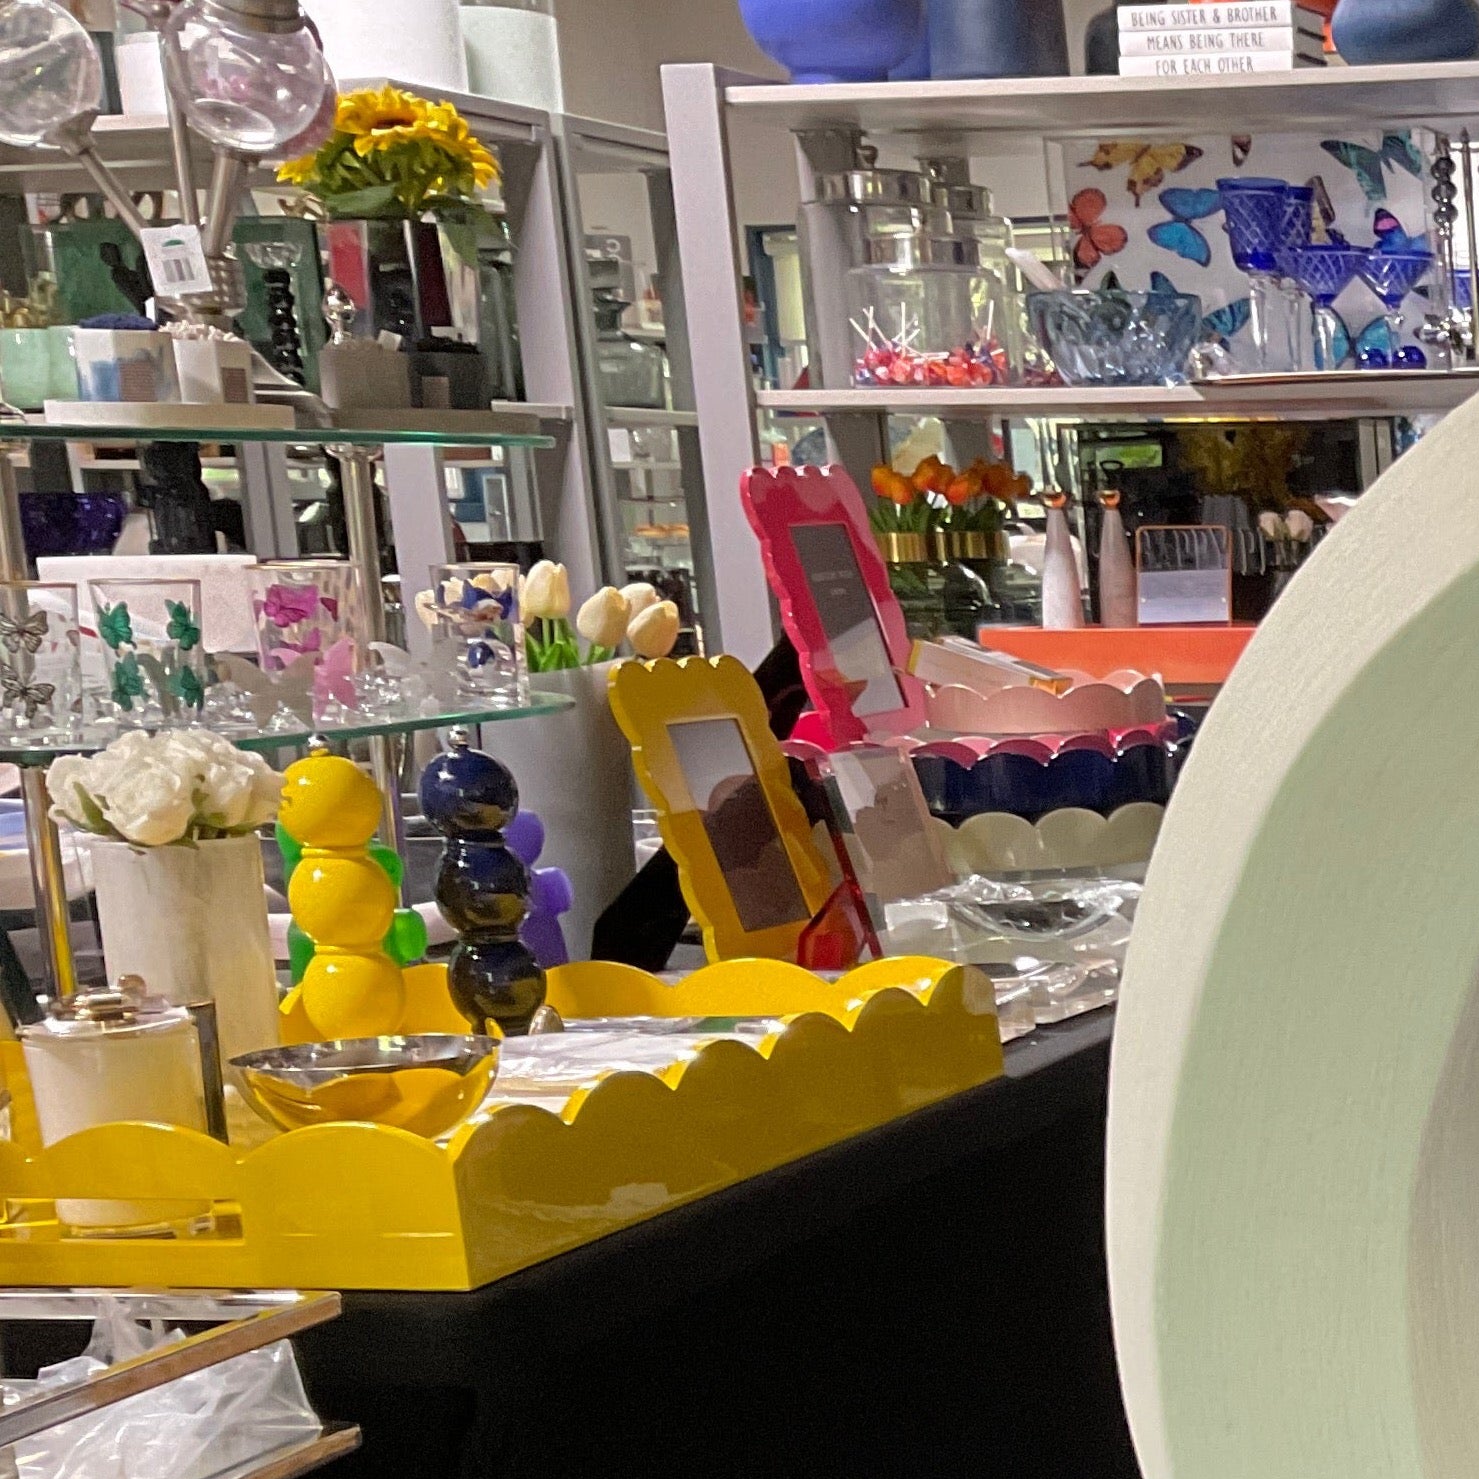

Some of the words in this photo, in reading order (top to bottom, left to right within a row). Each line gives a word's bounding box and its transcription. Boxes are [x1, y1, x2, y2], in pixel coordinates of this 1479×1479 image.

[1131, 11, 1165, 27] BEING
[1171, 9, 1207, 25] SISTER
[1213, 9, 1220, 23] &
[1228, 6, 1279, 22] BROTHER
[1147, 35, 1183, 50] MEANS
[1189, 33, 1224, 50] BEING
[1230, 31, 1264, 48] THERE
[1155, 58, 1177, 75] FOR
[1183, 57, 1211, 74] EACH
[1218, 56, 1254, 73] OTHER
